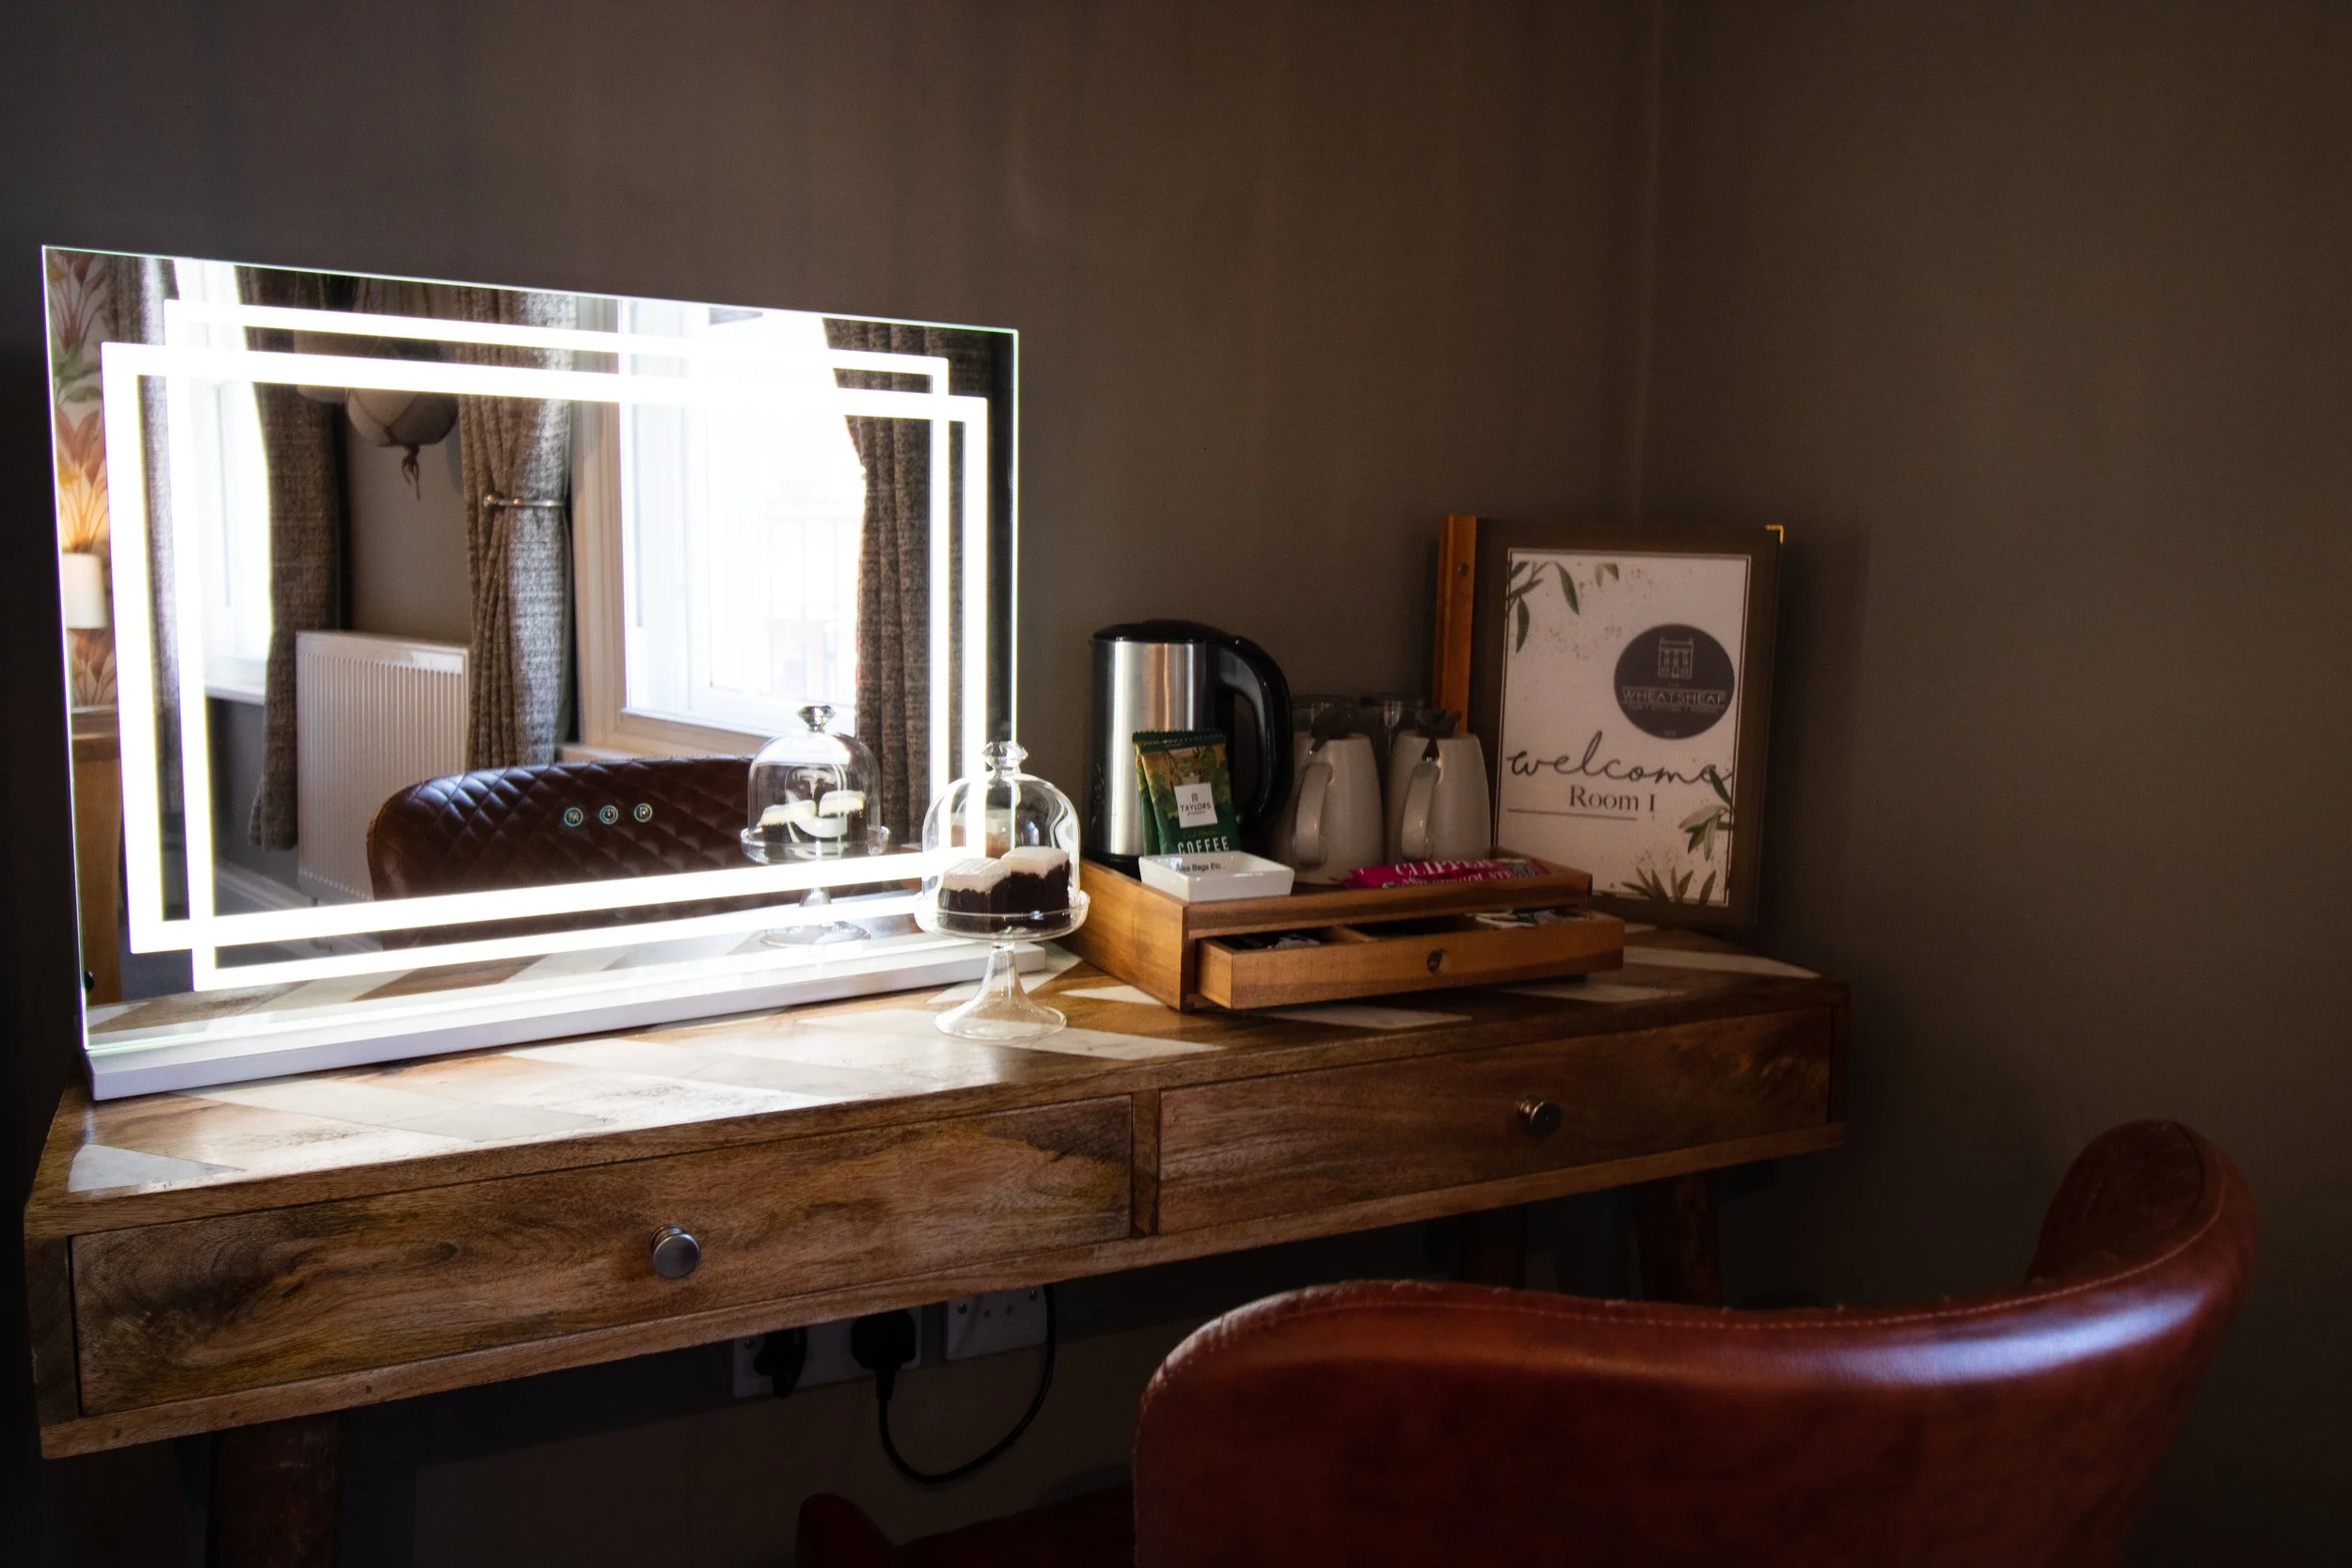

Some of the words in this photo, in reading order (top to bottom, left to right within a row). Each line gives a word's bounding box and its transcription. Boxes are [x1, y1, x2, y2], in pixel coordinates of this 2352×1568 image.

[1506, 730, 1732, 784] welcome
[1180, 801, 1211, 812] TAYLORS
[1569, 785, 1639, 812] Room
[1178, 835, 1229, 854] COFFEE
[1192, 863, 1209, 872] Bags
